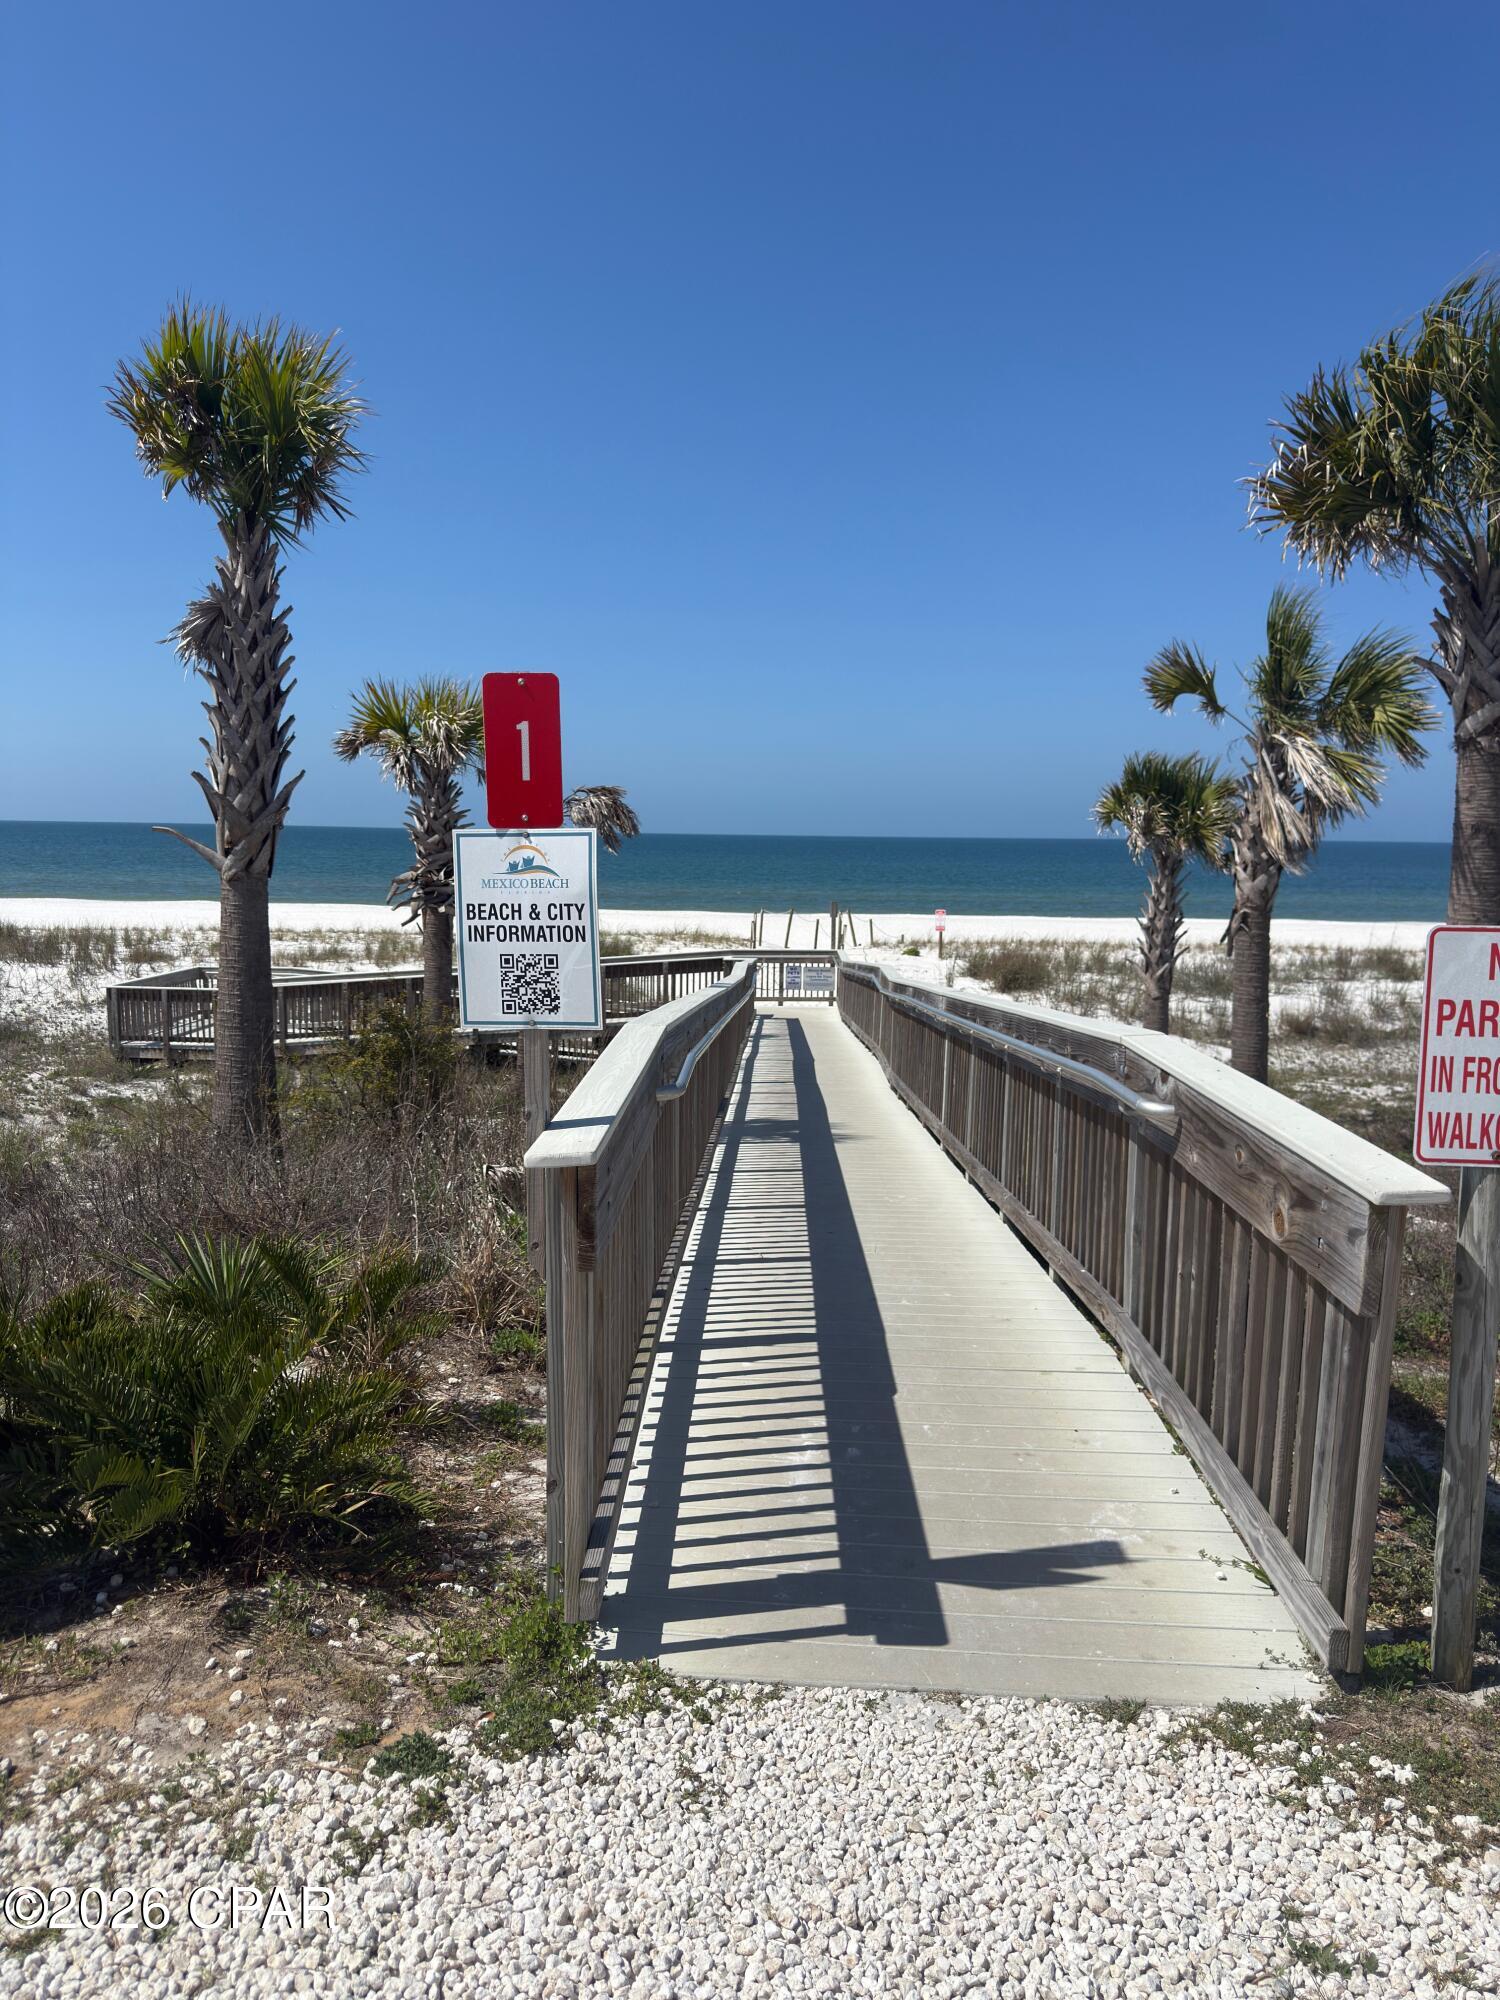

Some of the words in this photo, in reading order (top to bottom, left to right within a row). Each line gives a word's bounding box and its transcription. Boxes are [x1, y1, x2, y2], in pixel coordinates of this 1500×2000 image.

[515, 720, 531, 781] 1
[481, 878, 529, 889] MEXICO
[530, 878, 570, 889] BEACH
[466, 903, 522, 921] BEACH
[528, 903, 541, 921] &
[547, 902, 585, 921] CITY
[468, 924, 587, 943] INFORMATION
[1430, 1055, 1454, 1093] IN
[1428, 1112, 1500, 1150] WALK
